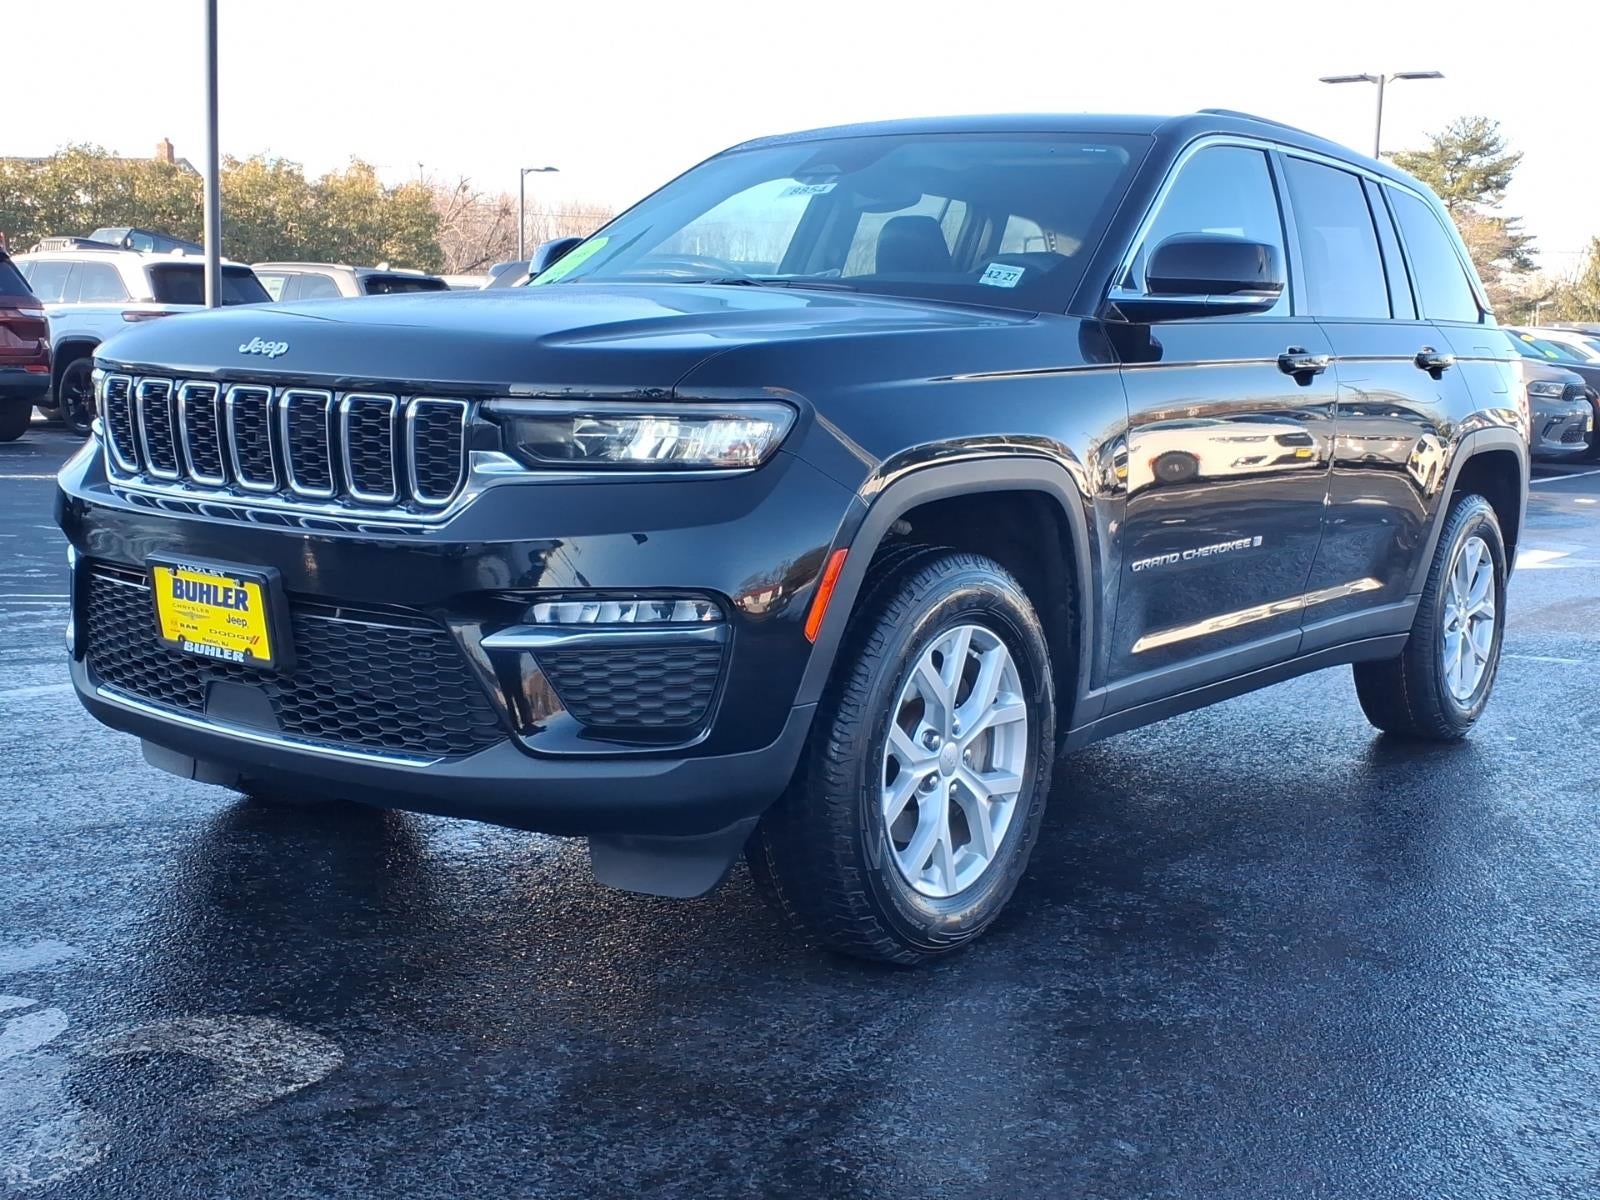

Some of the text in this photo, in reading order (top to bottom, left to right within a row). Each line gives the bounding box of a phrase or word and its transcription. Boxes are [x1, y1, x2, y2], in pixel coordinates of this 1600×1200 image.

[987, 270, 1017, 281] 12 27
[238, 337, 288, 358] Jeep
[1131, 538, 1251, 571] GRAND CHEROKEE
[172, 578, 249, 611] BUHLER
[179, 622, 198, 630] RAM
[226, 613, 248, 628] Jeep
[183, 641, 244, 662] BUHLER
